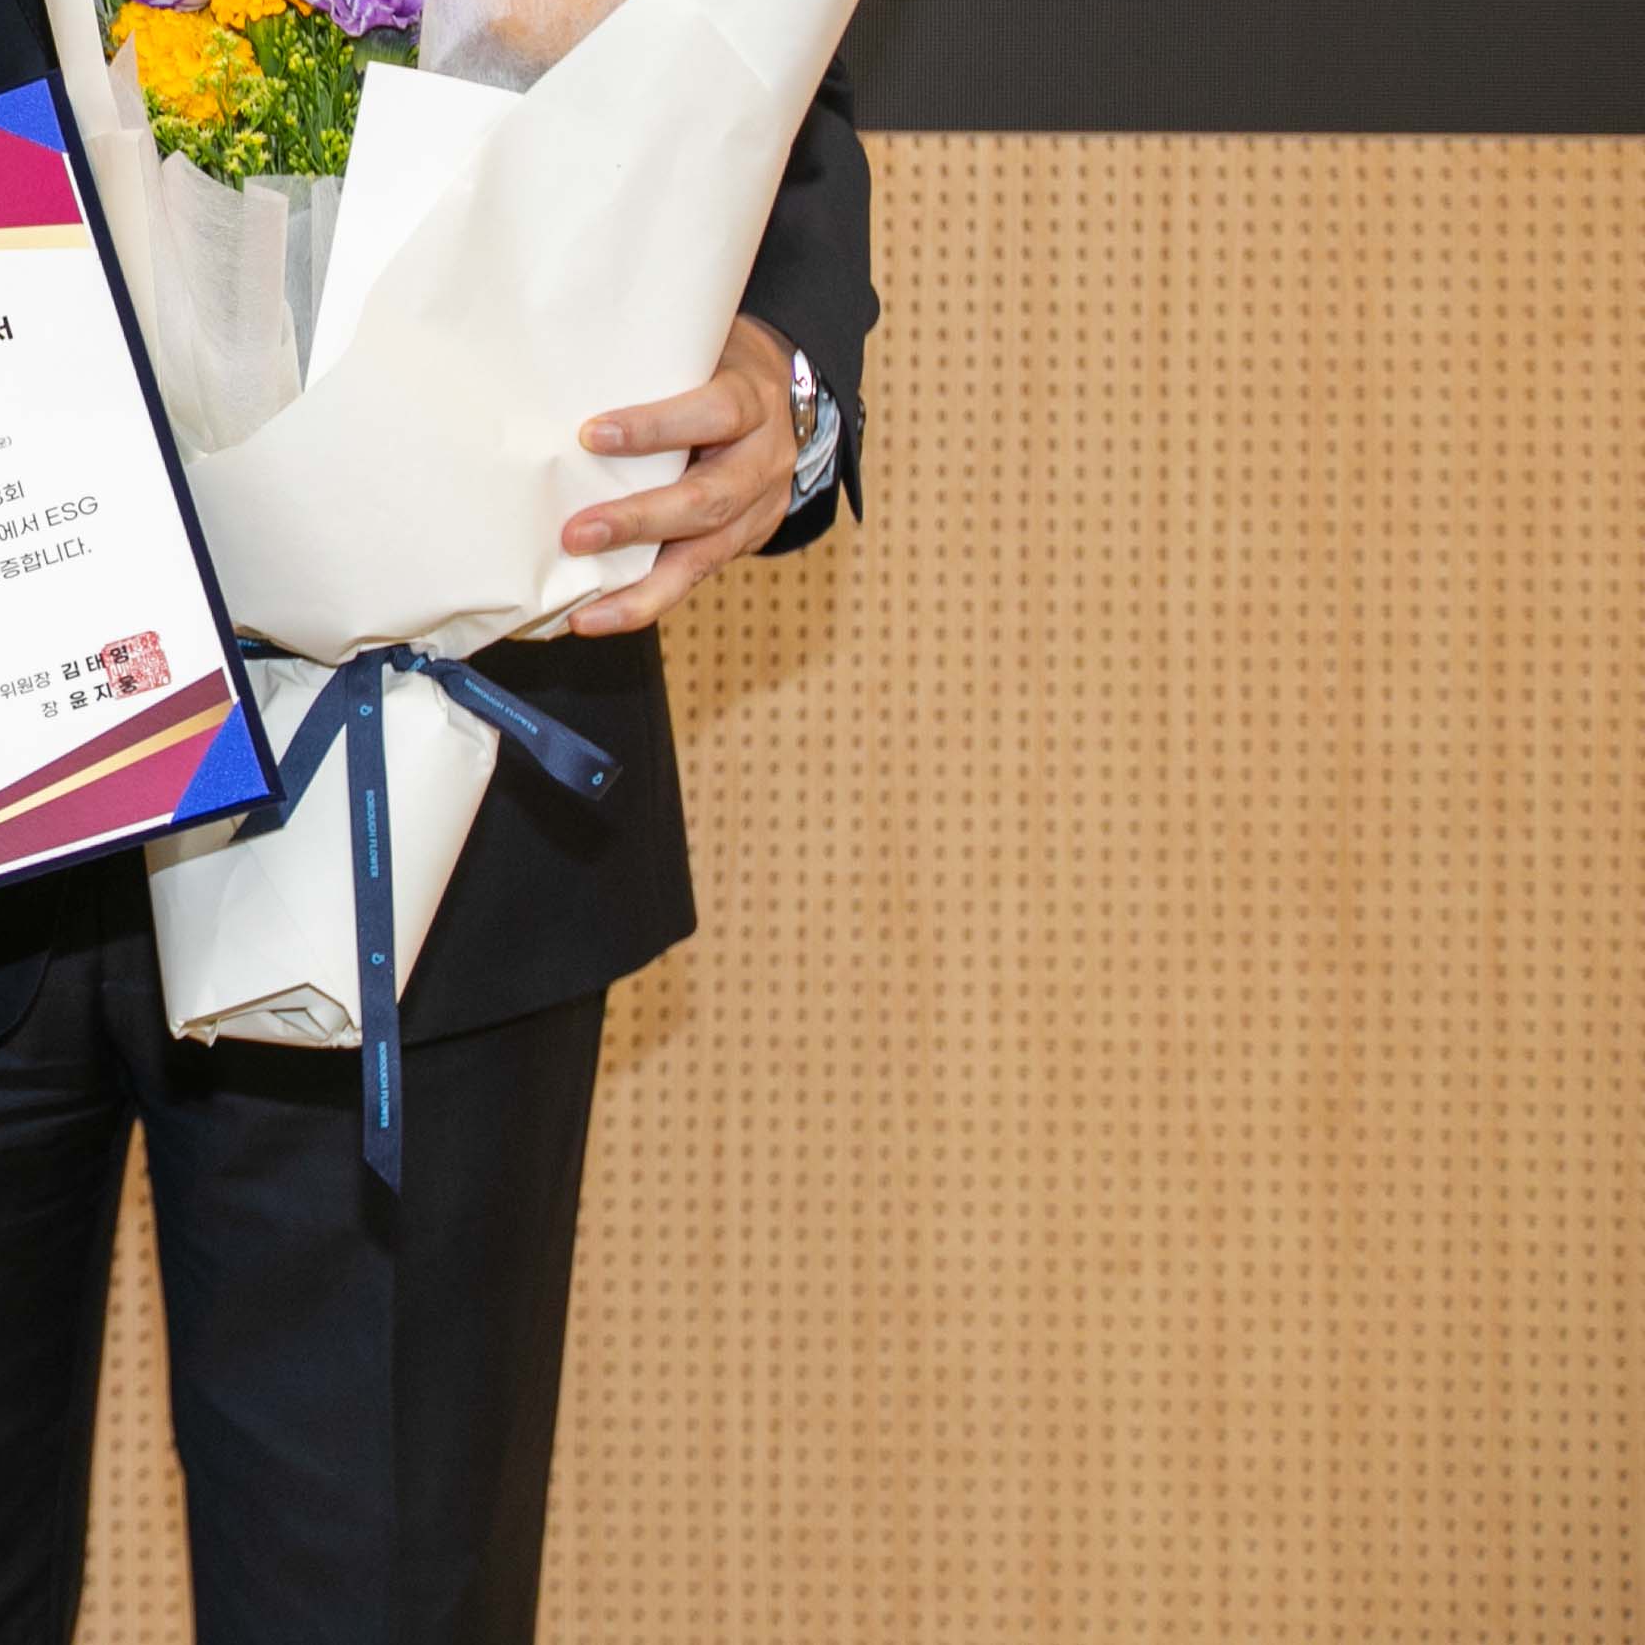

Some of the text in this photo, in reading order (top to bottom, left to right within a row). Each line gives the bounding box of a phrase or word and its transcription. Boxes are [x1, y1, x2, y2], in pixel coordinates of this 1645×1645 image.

[44, 495, 99, 527] ESG
[0, 671, 51, 700] 위원장
[369, 838, 379, 878] FLOWER
